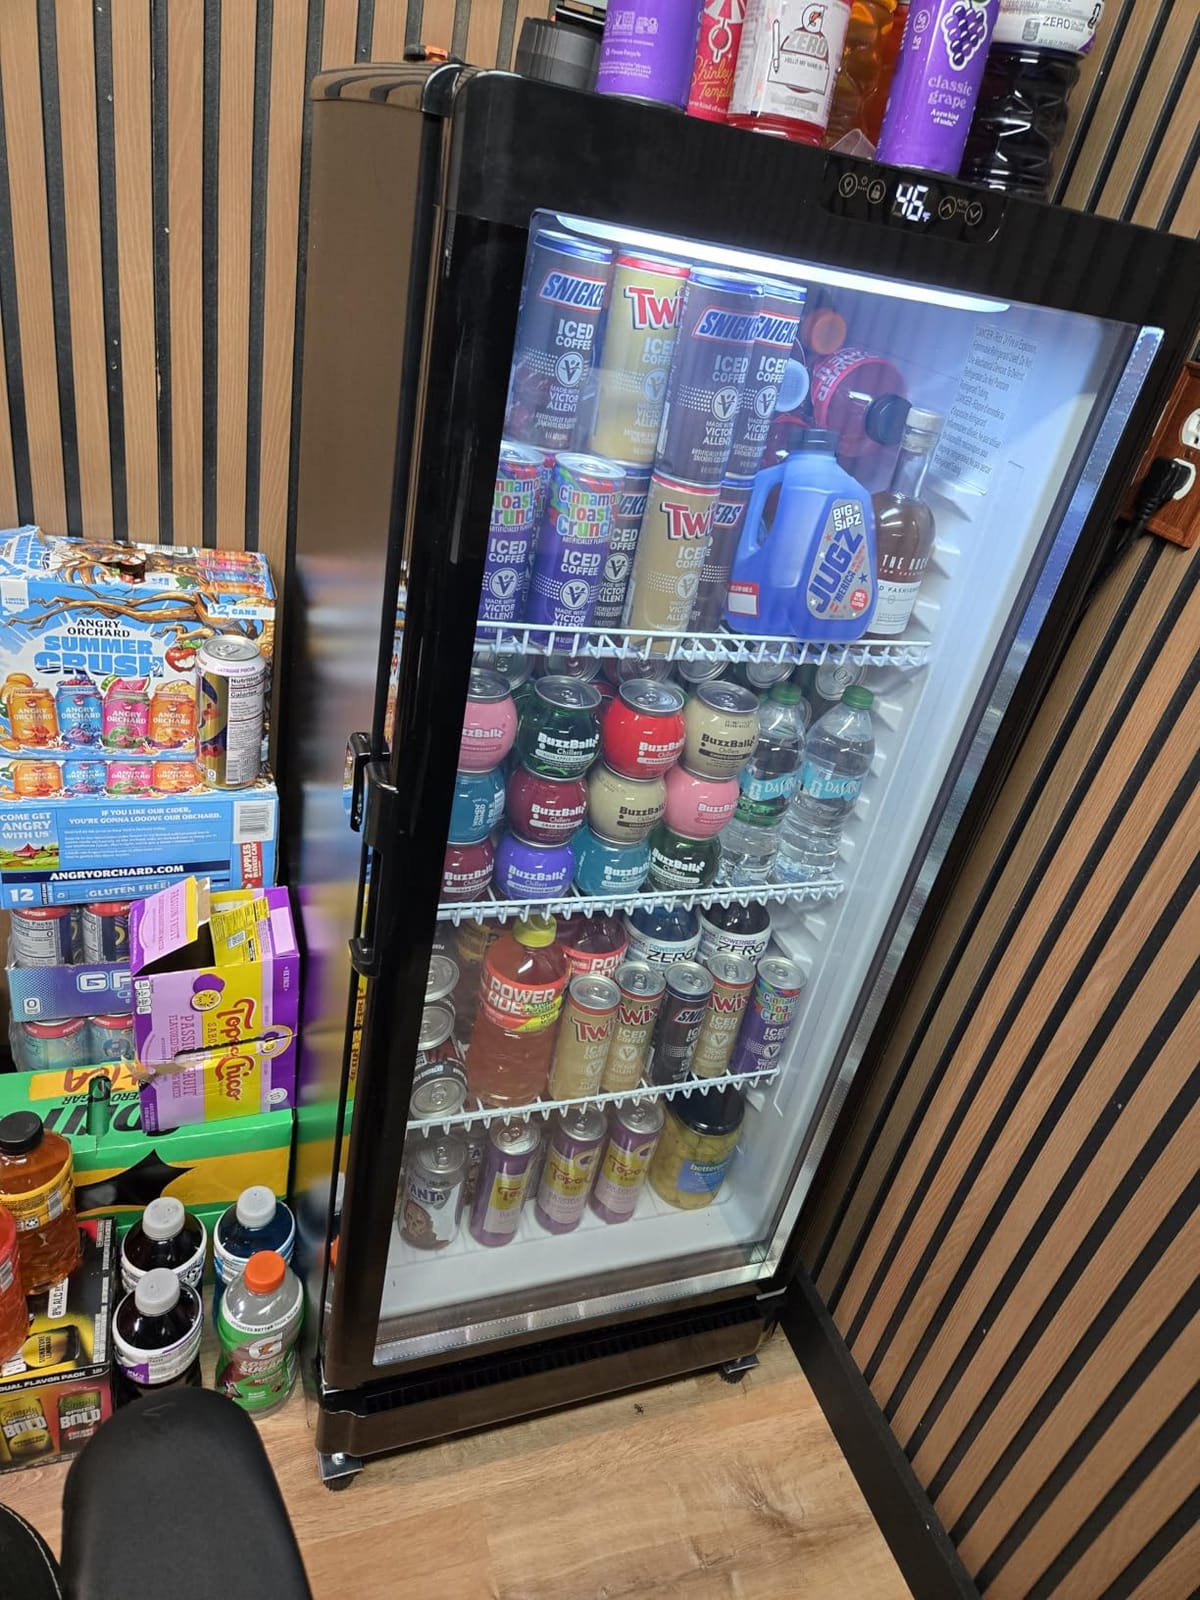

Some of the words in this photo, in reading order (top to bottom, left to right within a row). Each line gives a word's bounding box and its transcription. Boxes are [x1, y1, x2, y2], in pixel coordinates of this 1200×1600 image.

[1042, 16, 1070, 30] ZERO
[786, 31, 828, 58] ZERO
[927, 74, 974, 96] classic
[927, 91, 967, 110] grape
[895, 183, 929, 222] 46
[558, 319, 594, 339] ICED
[555, 335, 591, 350] COFFEE
[715, 355, 749, 374] ICED
[712, 371, 746, 384] COFFEE
[568, 502, 612, 522] Toast
[832, 504, 854, 521] BIG
[834, 512, 863, 532] SIPZ
[490, 538, 527, 555] ICED
[489, 552, 526, 565] COFFEE
[563, 549, 601, 567] ICED
[882, 554, 904, 570] THE
[561, 563, 600, 577] COFFEE
[808, 528, 864, 614] JUGZ
[231, 608, 257, 617] CANS
[485, 604, 515, 613] VICTOR
[77, 617, 120, 629] ANGRY
[554, 612, 586, 623] VICTOR
[67, 627, 131, 639] ORCHARD
[43, 634, 154, 655] SUMMER
[34, 650, 165, 679] CRUSH
[19, 706, 48, 715] ANGRY
[61, 711, 101, 720] ORCHARD
[65, 706, 95, 714] ANGRY
[112, 710, 142, 718] ANGRY
[158, 711, 187, 719] ANGRY
[106, 716, 147, 725] ORCHARD
[153, 717, 191, 726] ORCHARD
[537, 731, 597, 751] BuzzBallz
[701, 732, 754, 749] BuzzBallz
[1, 813, 30, 822] COME
[31, 812, 52, 821] GET
[99, 816, 129, 825] GONNA
[164, 814, 181, 822] OUR
[181, 812, 222, 820] ORCHARD.
[101, 809, 108, 817] IF
[110, 808, 128, 817] YOU
[128, 808, 146, 817] LIKE
[147, 807, 165, 816] OUR
[166, 806, 192, 815] CIDER,
[531, 803, 585, 818] BuzzBallz
[2, 820, 52, 832] ANGRY
[2, 831, 33, 840] WITH
[34, 830, 49, 839] US
[242, 844, 253, 873] APPLES
[652, 848, 702, 874] BuzzBallz
[50, 864, 185, 881] ANGRYORCHARD.COM
[508, 864, 566, 881] BuzzBallz
[10, 888, 35, 903] 12
[87, 885, 136, 898] GLUTEN
[646, 947, 697, 964] ZERO
[490, 975, 556, 1004] POWER
[214, 1055, 256, 1101] Chico
[25, 1376, 60, 1387] FLAVOR
[61, 1371, 87, 1381] PACK
[60, 1408, 101, 1430] BOLD
[3, 1416, 48, 1439] BOLD
